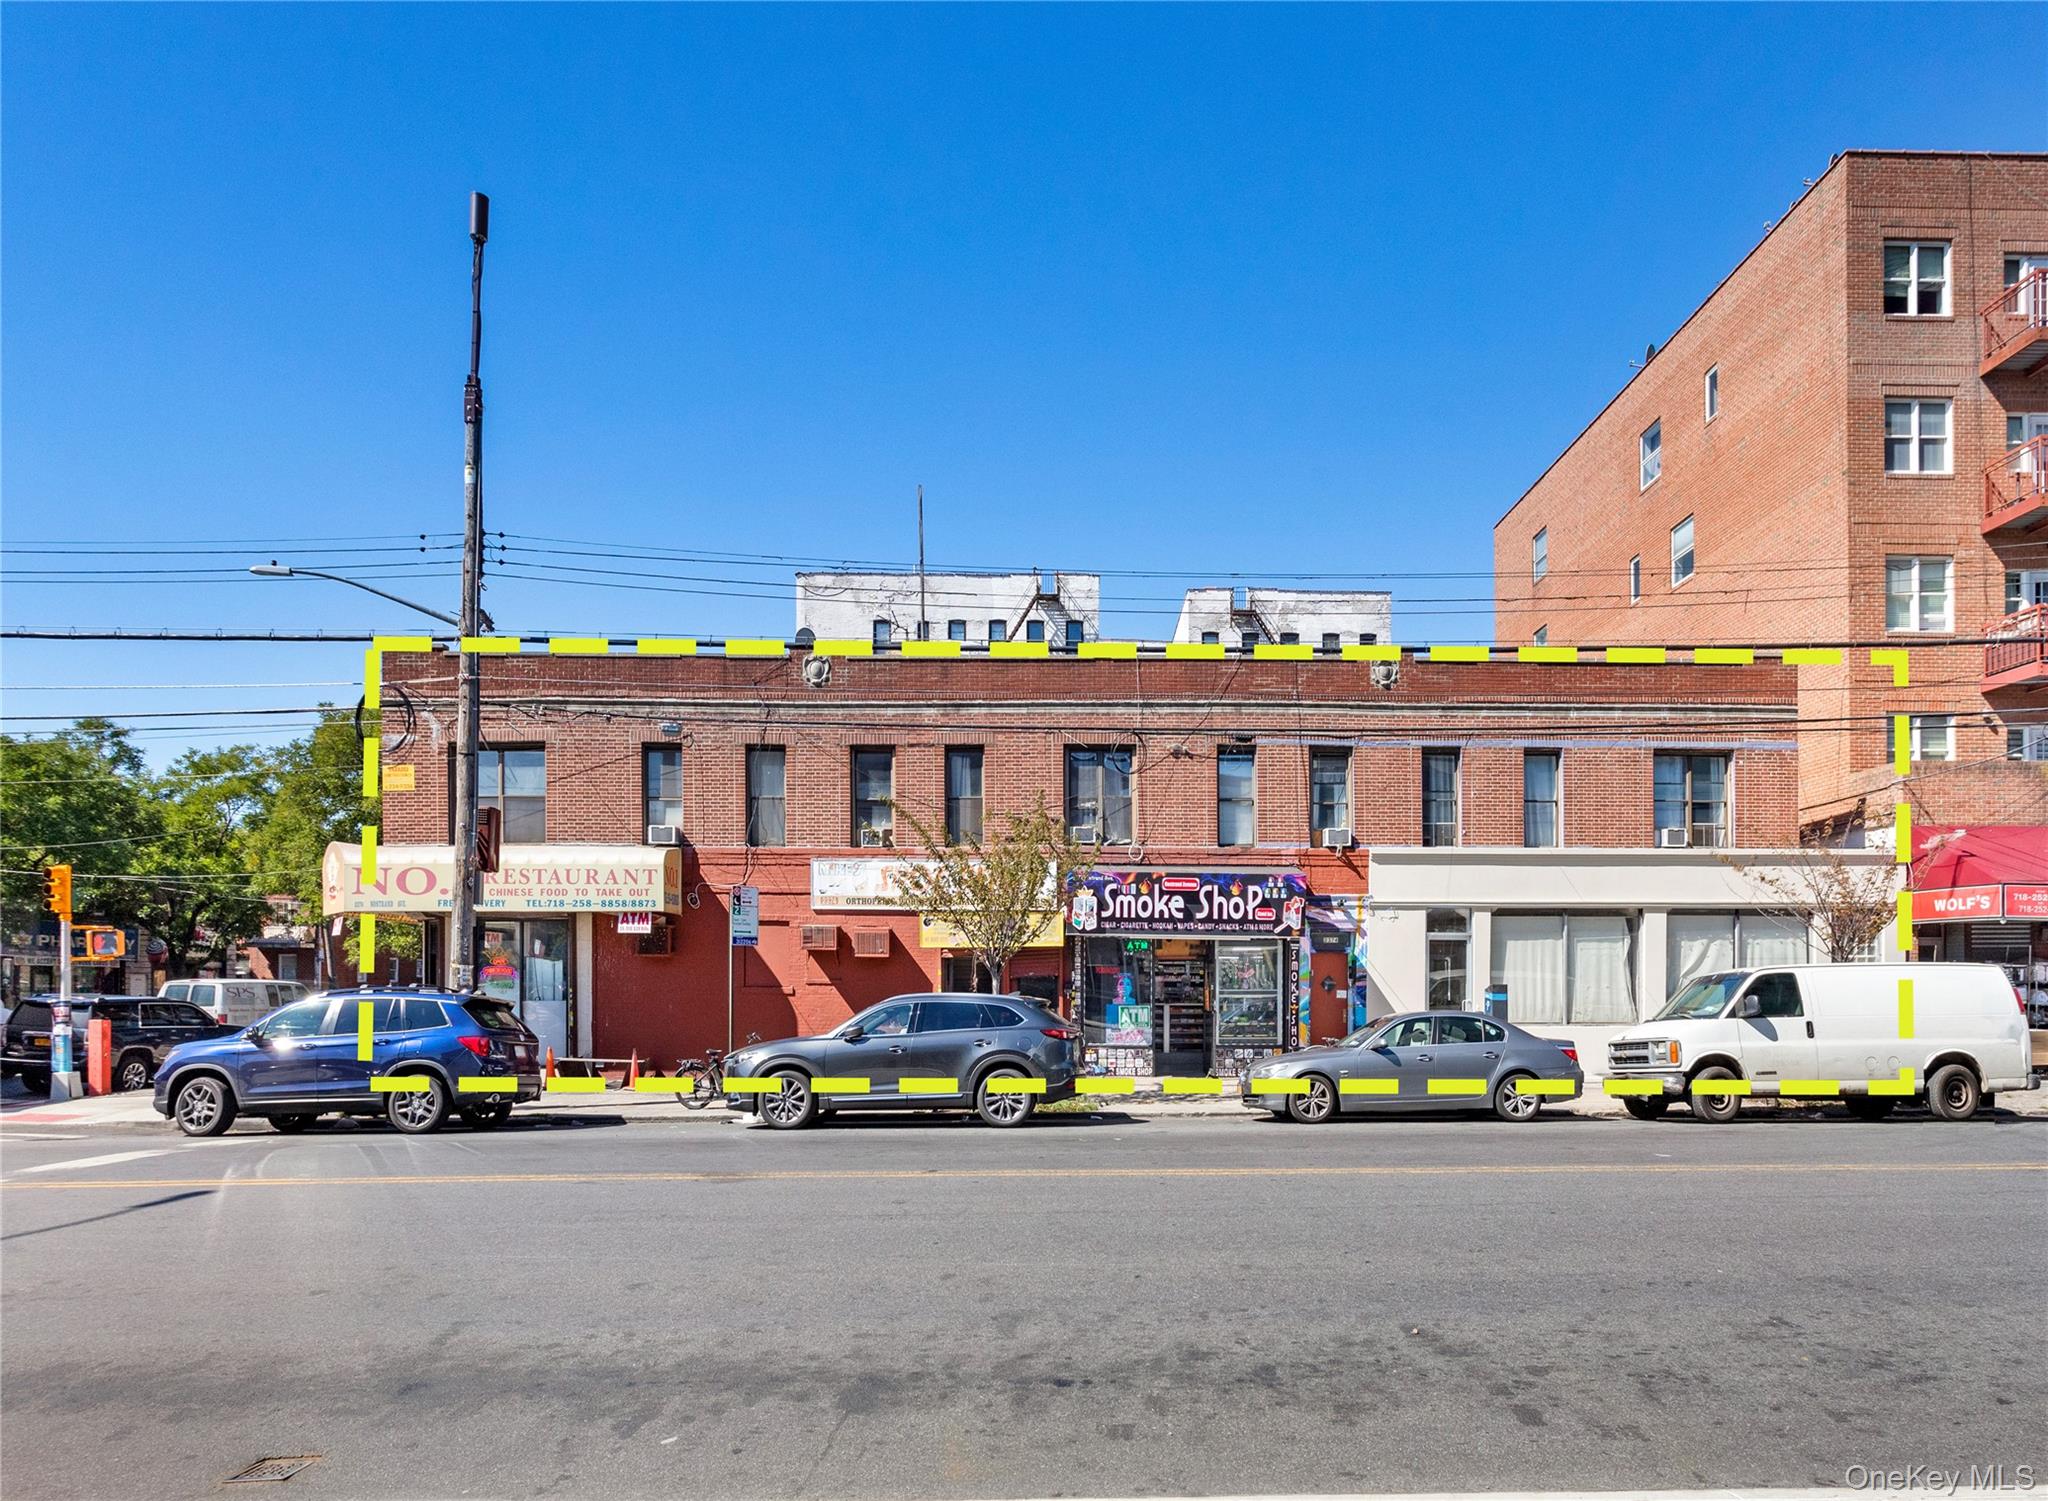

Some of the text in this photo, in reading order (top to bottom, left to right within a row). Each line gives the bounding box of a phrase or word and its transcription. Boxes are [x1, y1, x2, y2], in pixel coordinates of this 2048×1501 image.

[484, 868, 658, 885] RESTAURANT
[488, 888, 650, 897] CHINESE FOOD TO TAKE OUT
[1101, 883, 1185, 919] Smoke
[1934, 895, 1990, 912] WOLF'S
[621, 912, 650, 925] ATM
[486, 933, 501, 943] TM
[1126, 941, 1148, 950] ATM
[1291, 950, 1299, 1004] SMOKE
[1121, 1008, 1149, 1024] ATM
[1116, 1067, 1136, 1076] SMOKE
[1137, 1067, 1153, 1076] SHOP
[1216, 1068, 1237, 1077] SMOKE
